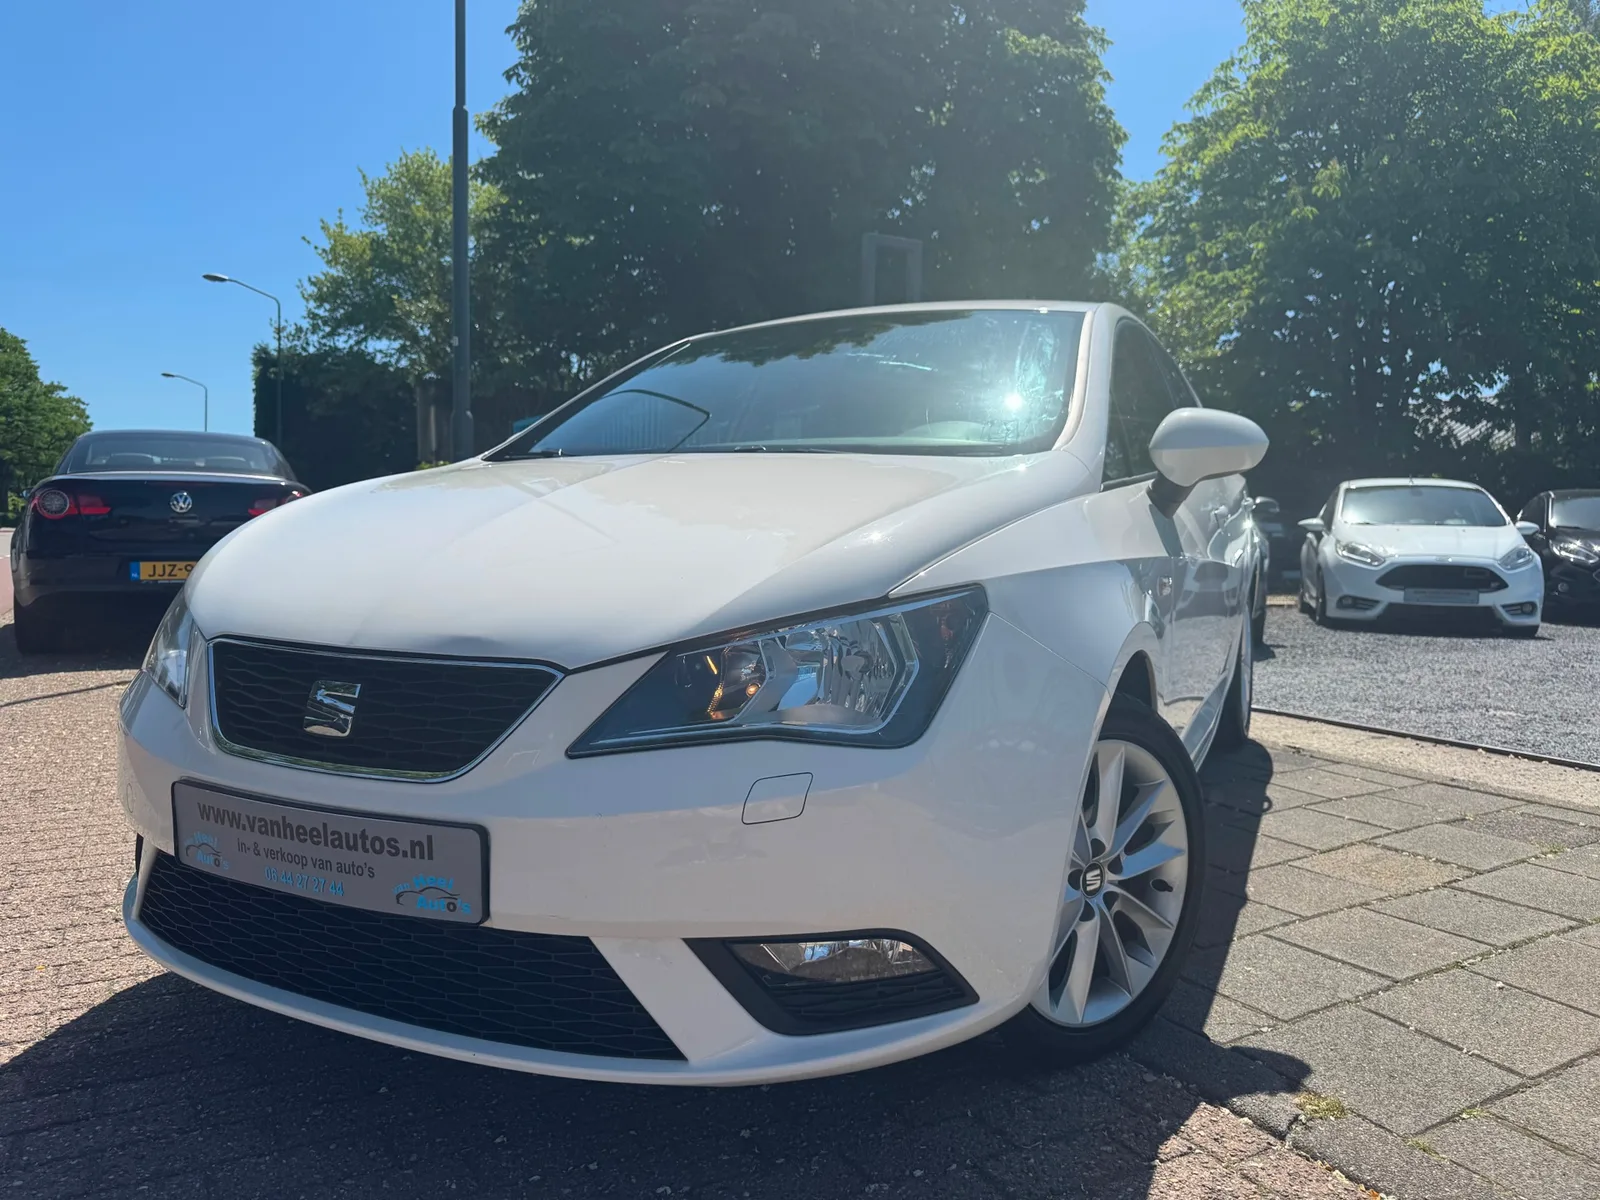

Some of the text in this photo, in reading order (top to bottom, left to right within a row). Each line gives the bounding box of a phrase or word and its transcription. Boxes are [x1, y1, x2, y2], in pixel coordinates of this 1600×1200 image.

[197, 802, 434, 861] www.vanheelautos.nl
[253, 841, 261, 856] &
[263, 846, 308, 870] verkoop
[310, 856, 332, 872] van
[336, 861, 375, 879] auto's
[264, 866, 345, 896] 06 44 27 27 44
[412, 874, 455, 891] Heel
[416, 895, 471, 914] Auto's
